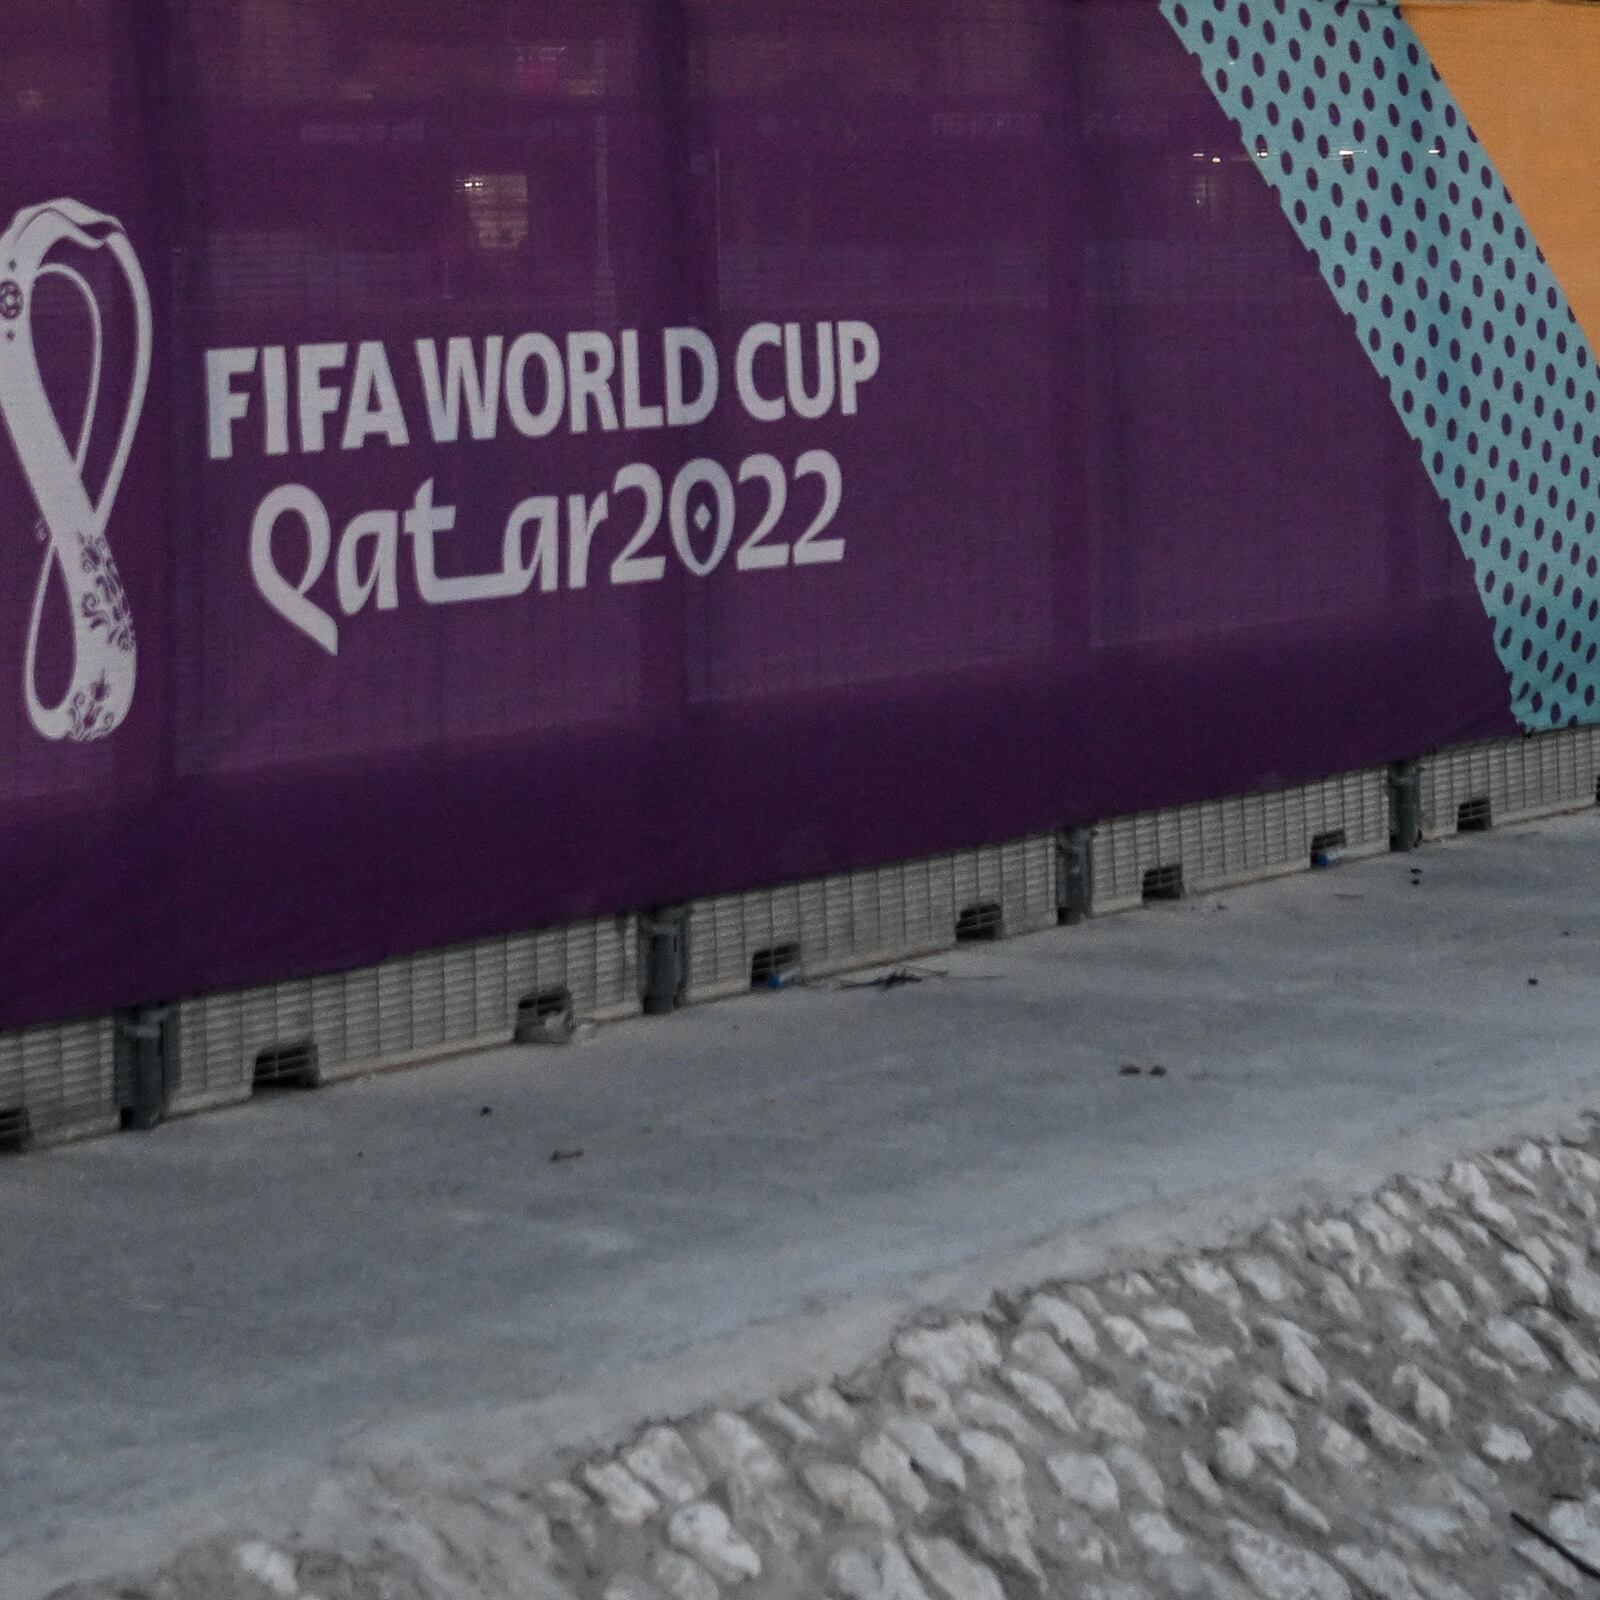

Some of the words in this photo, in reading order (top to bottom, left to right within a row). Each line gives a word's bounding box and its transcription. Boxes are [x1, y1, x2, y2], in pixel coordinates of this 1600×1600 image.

[206, 341, 410, 459] FIFA
[415, 327, 719, 443] WORLD
[735, 320, 880, 421] CUP
